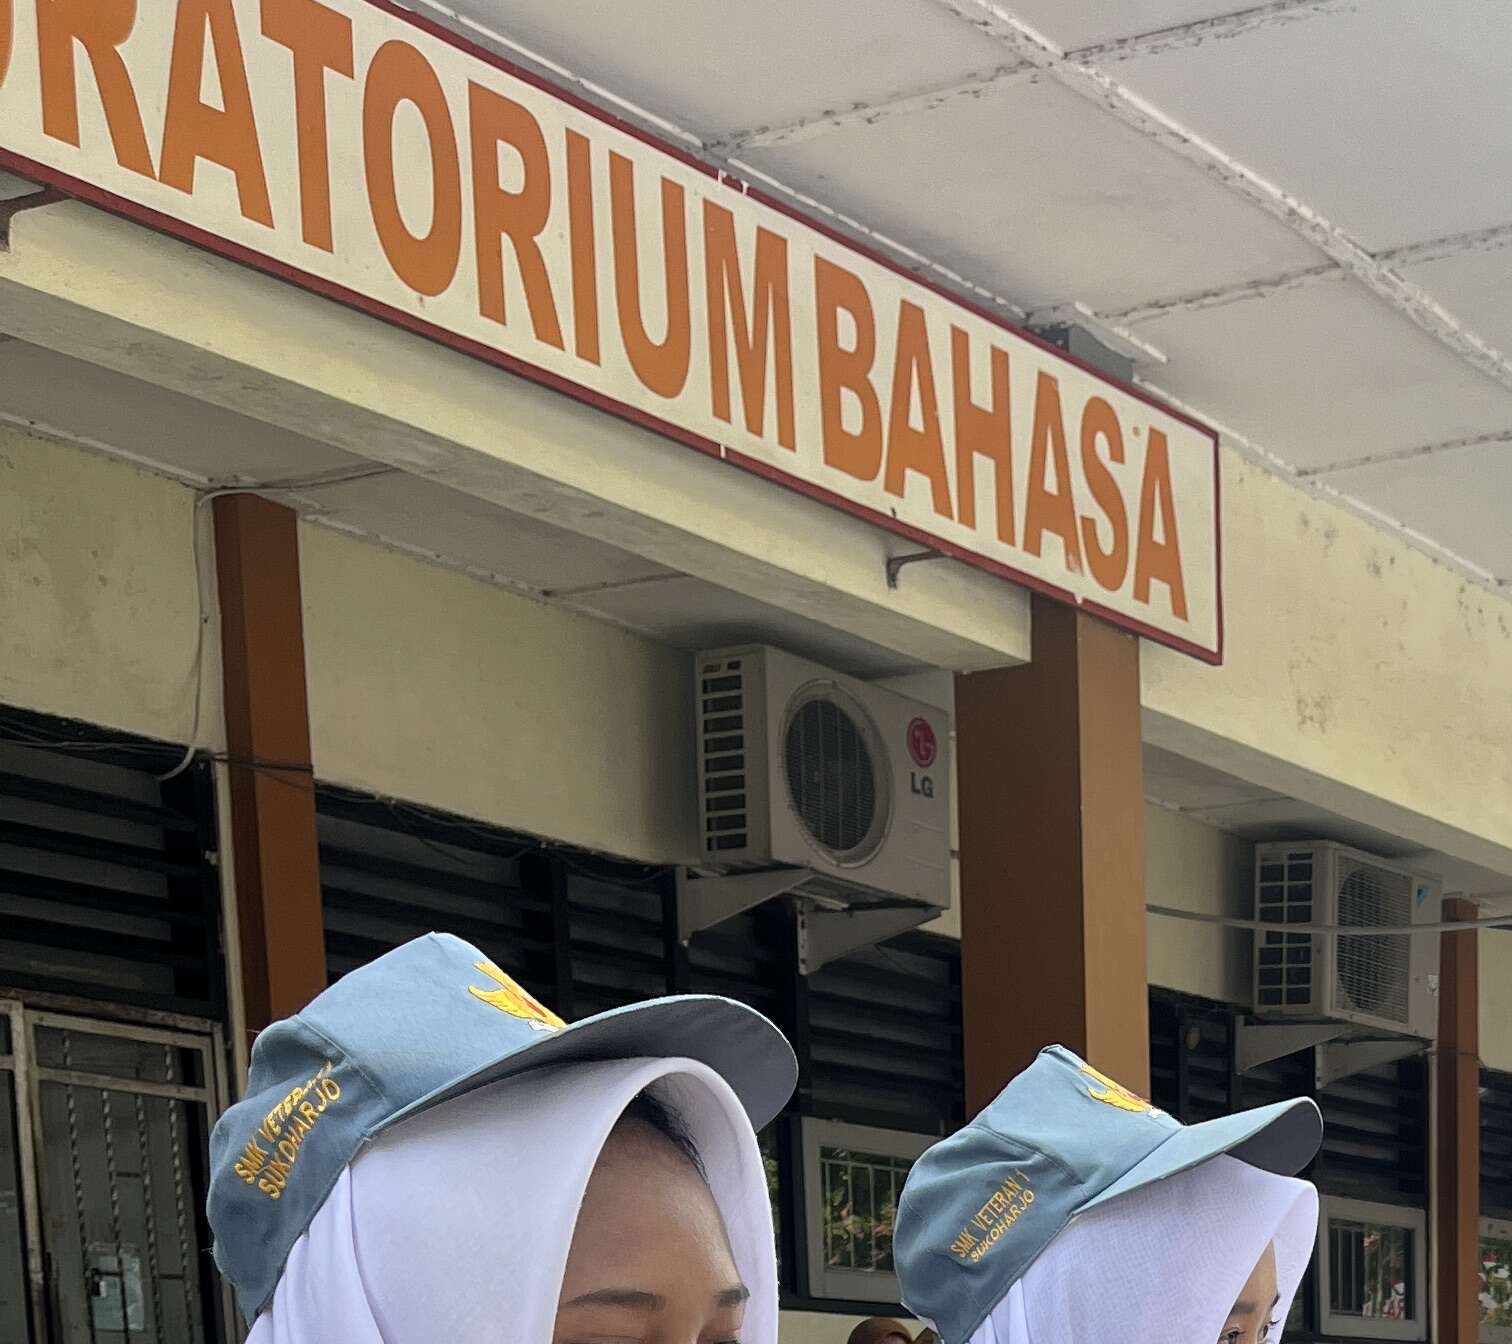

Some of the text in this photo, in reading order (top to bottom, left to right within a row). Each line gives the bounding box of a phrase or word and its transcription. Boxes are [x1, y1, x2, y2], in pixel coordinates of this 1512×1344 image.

[0, 0, 1189, 622] RATORIUM BAHASA
[910, 771, 934, 799] LG
[950, 1227, 980, 1259] SMK
[970, 1175, 1024, 1232] VETERAN
[968, 1189, 1035, 1263] SUKOHARJO
